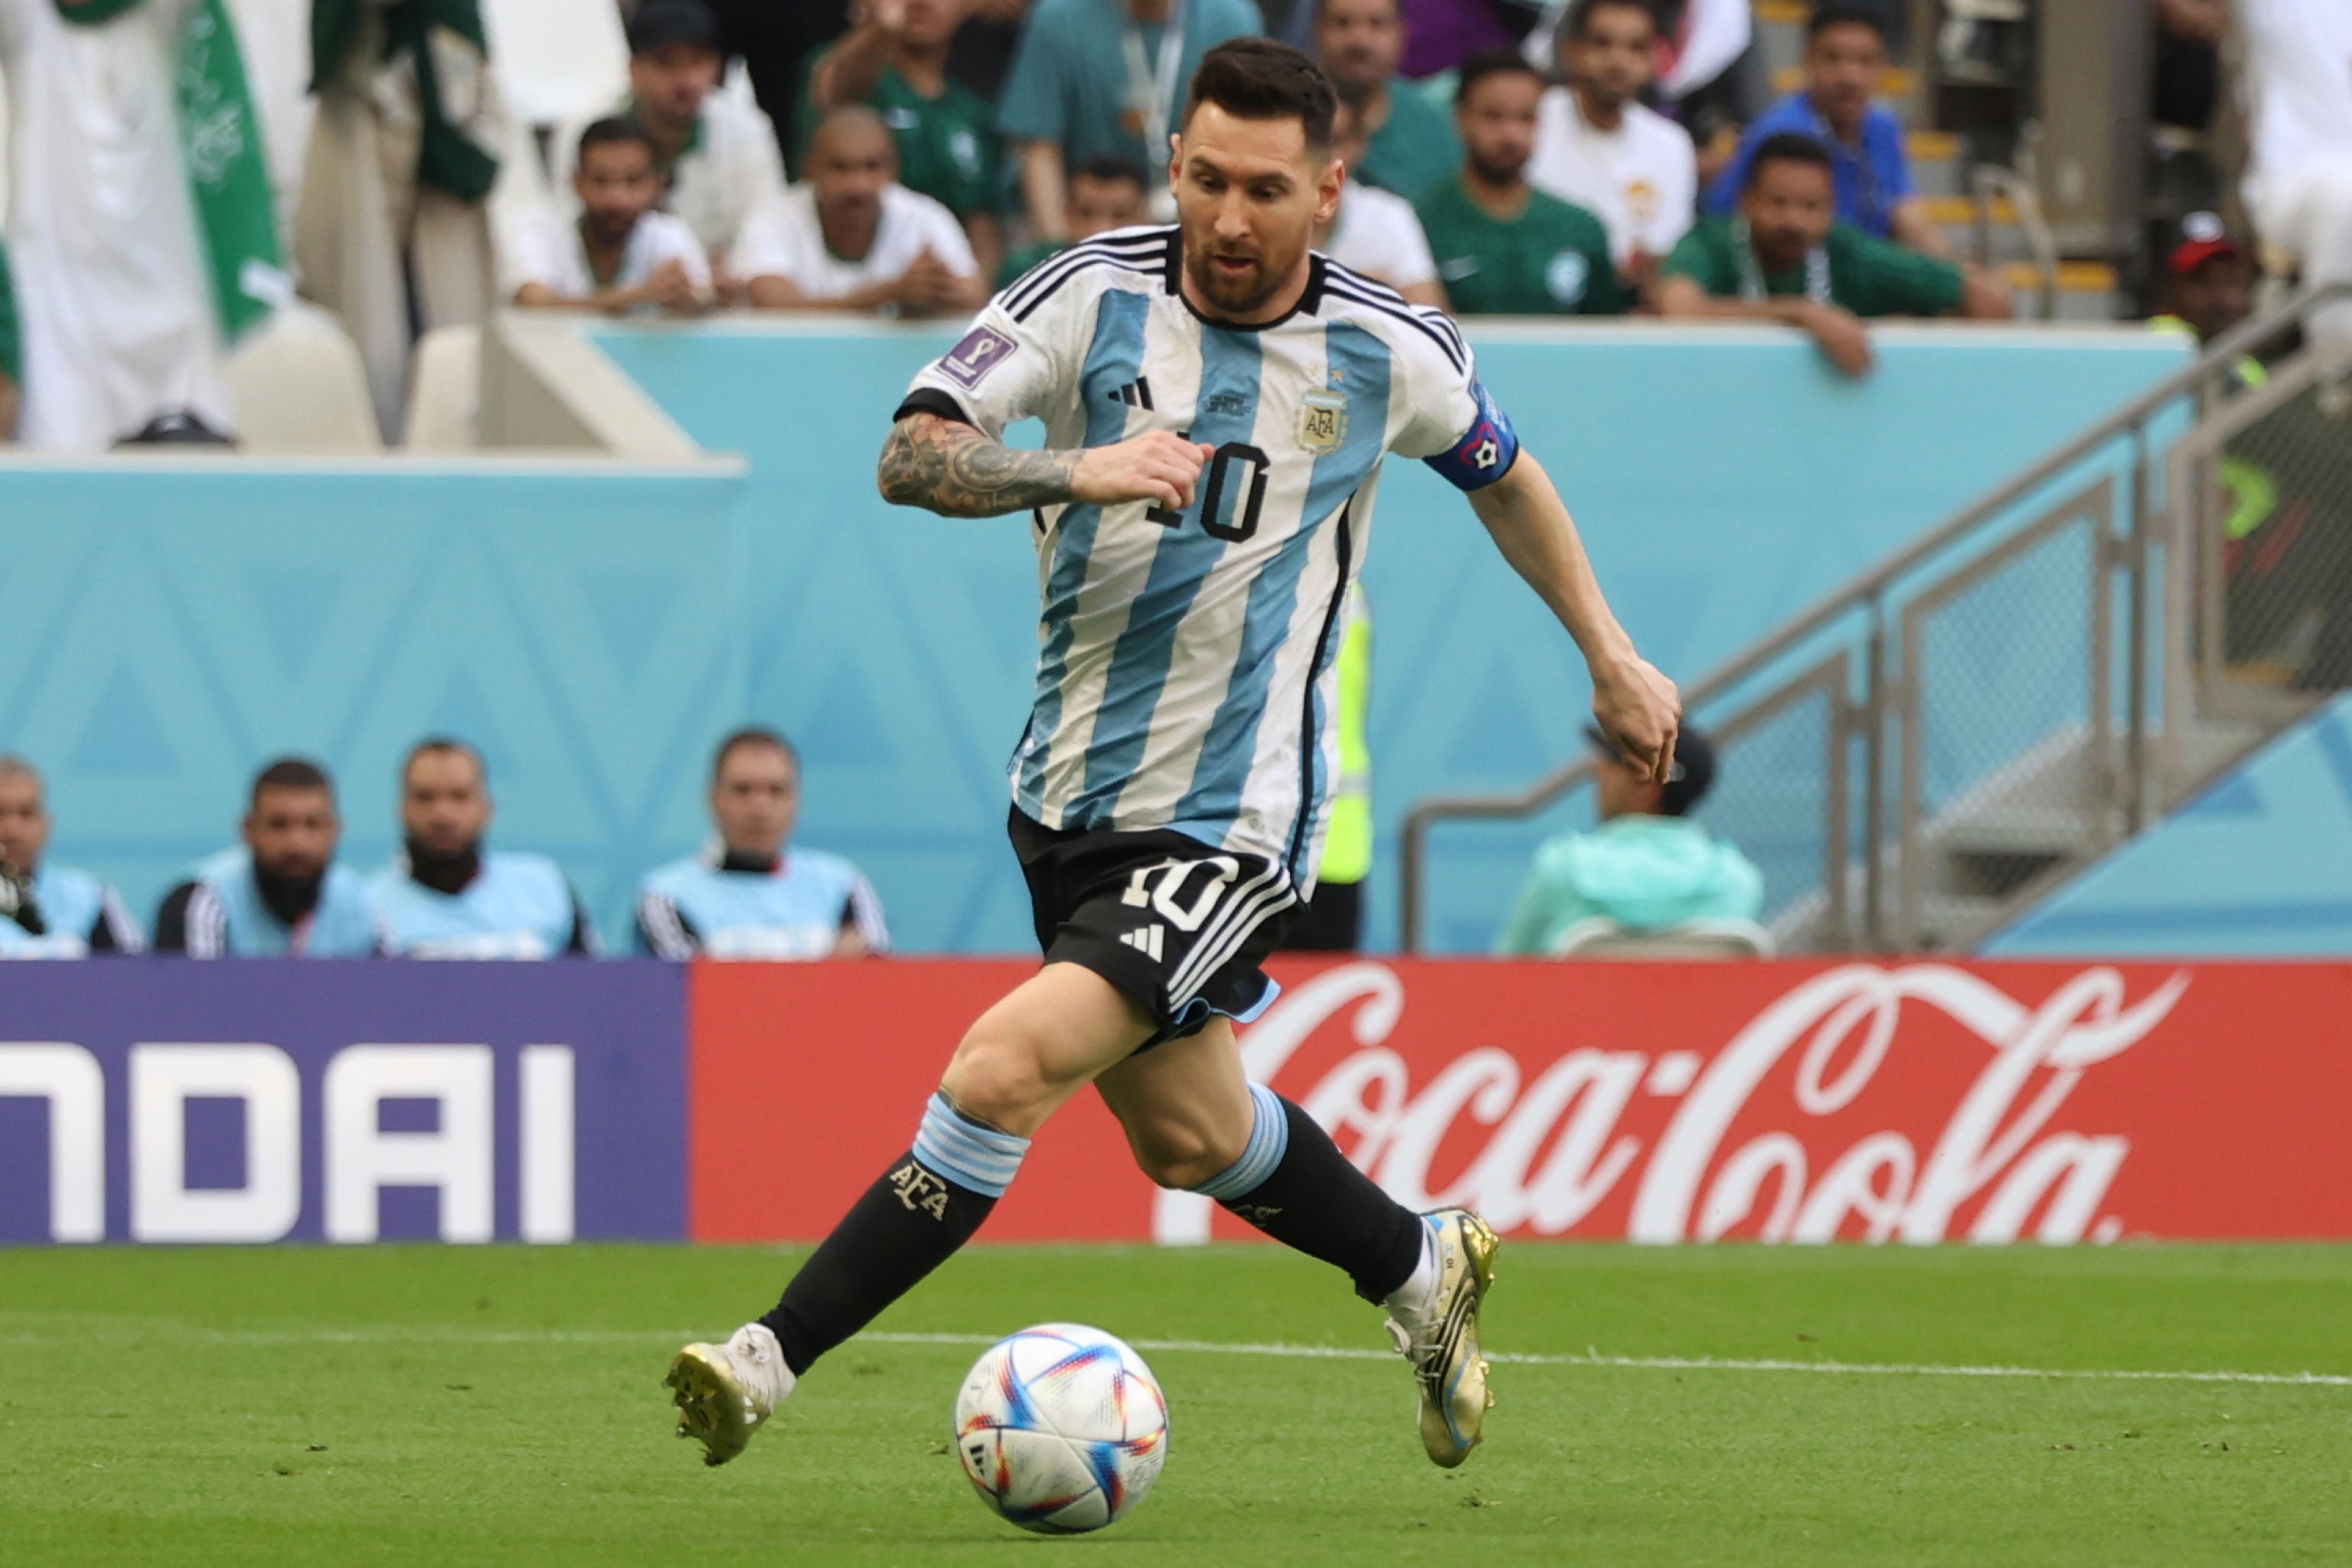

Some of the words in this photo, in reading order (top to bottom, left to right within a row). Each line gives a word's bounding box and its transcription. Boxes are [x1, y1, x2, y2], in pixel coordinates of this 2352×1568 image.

[1305, 407, 1334, 439] AFA
[1145, 430, 1272, 544] 0
[1121, 856, 1240, 932] 10
[889, 1158, 949, 1222] AFA
